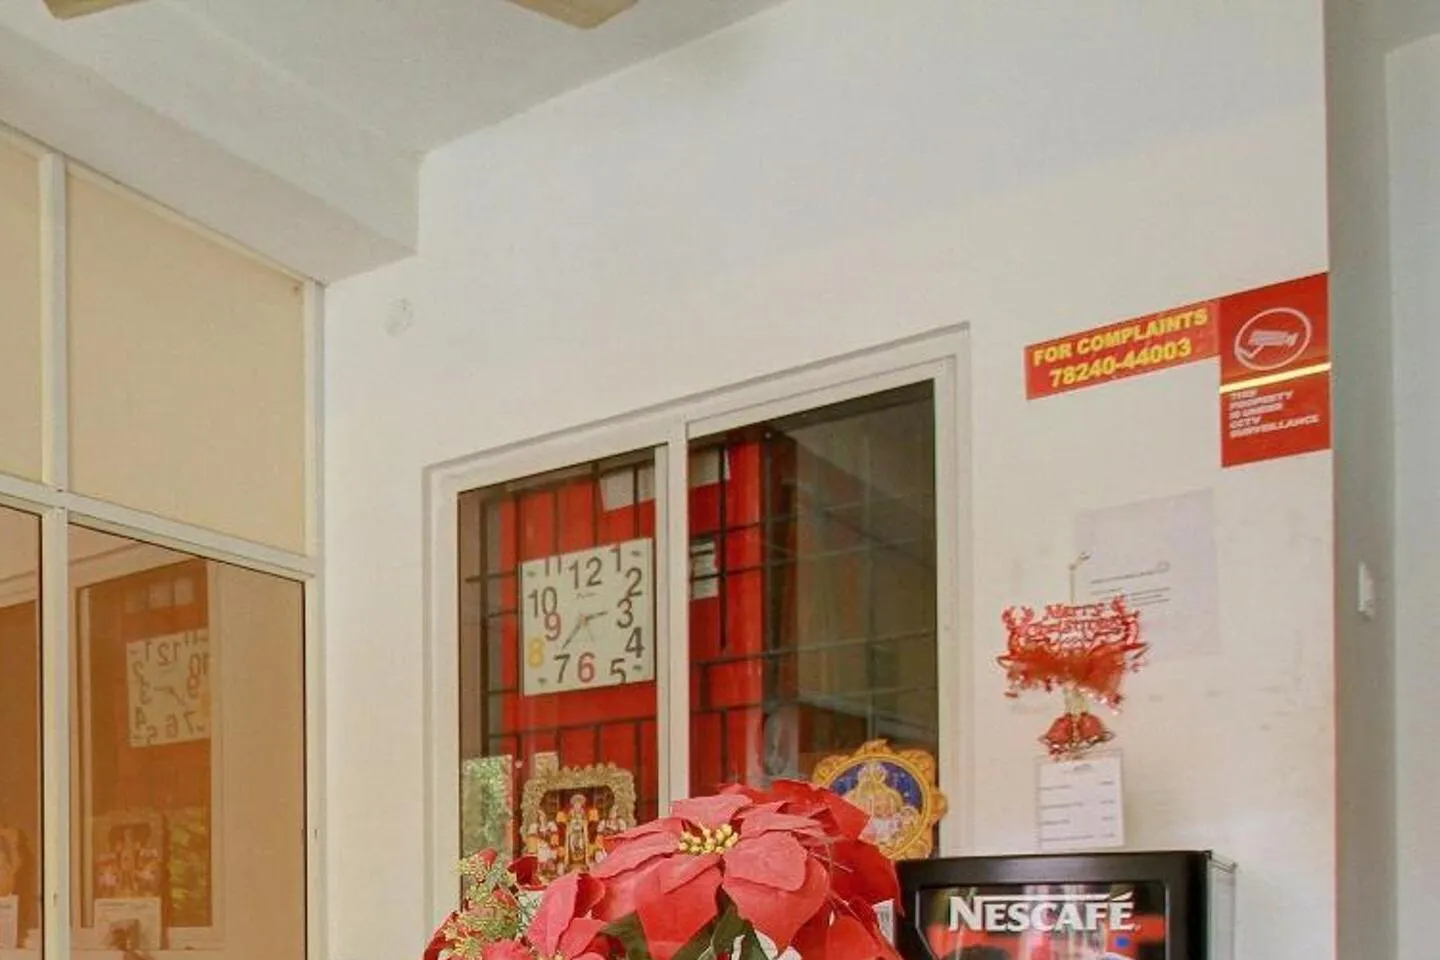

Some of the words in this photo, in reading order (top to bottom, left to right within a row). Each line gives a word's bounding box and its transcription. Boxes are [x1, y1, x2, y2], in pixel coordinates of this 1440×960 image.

[1033, 342, 1072, 367] FOR
[1076, 307, 1208, 355] COMPLAINTS
[1049, 336, 1193, 388] 78240-44003
[527, 586, 558, 619] 10
[625, 567, 643, 597] 2
[568, 556, 603, 589] 12
[544, 612, 561, 641] 9
[616, 598, 634, 629] 3
[528, 637, 545, 669] 8
[625, 626, 645, 659] 4
[553, 653, 571, 684] 7
[578, 651, 595, 683] 6
[610, 657, 627, 684] 5
[948, 890, 1136, 932] NESCAFÉ
